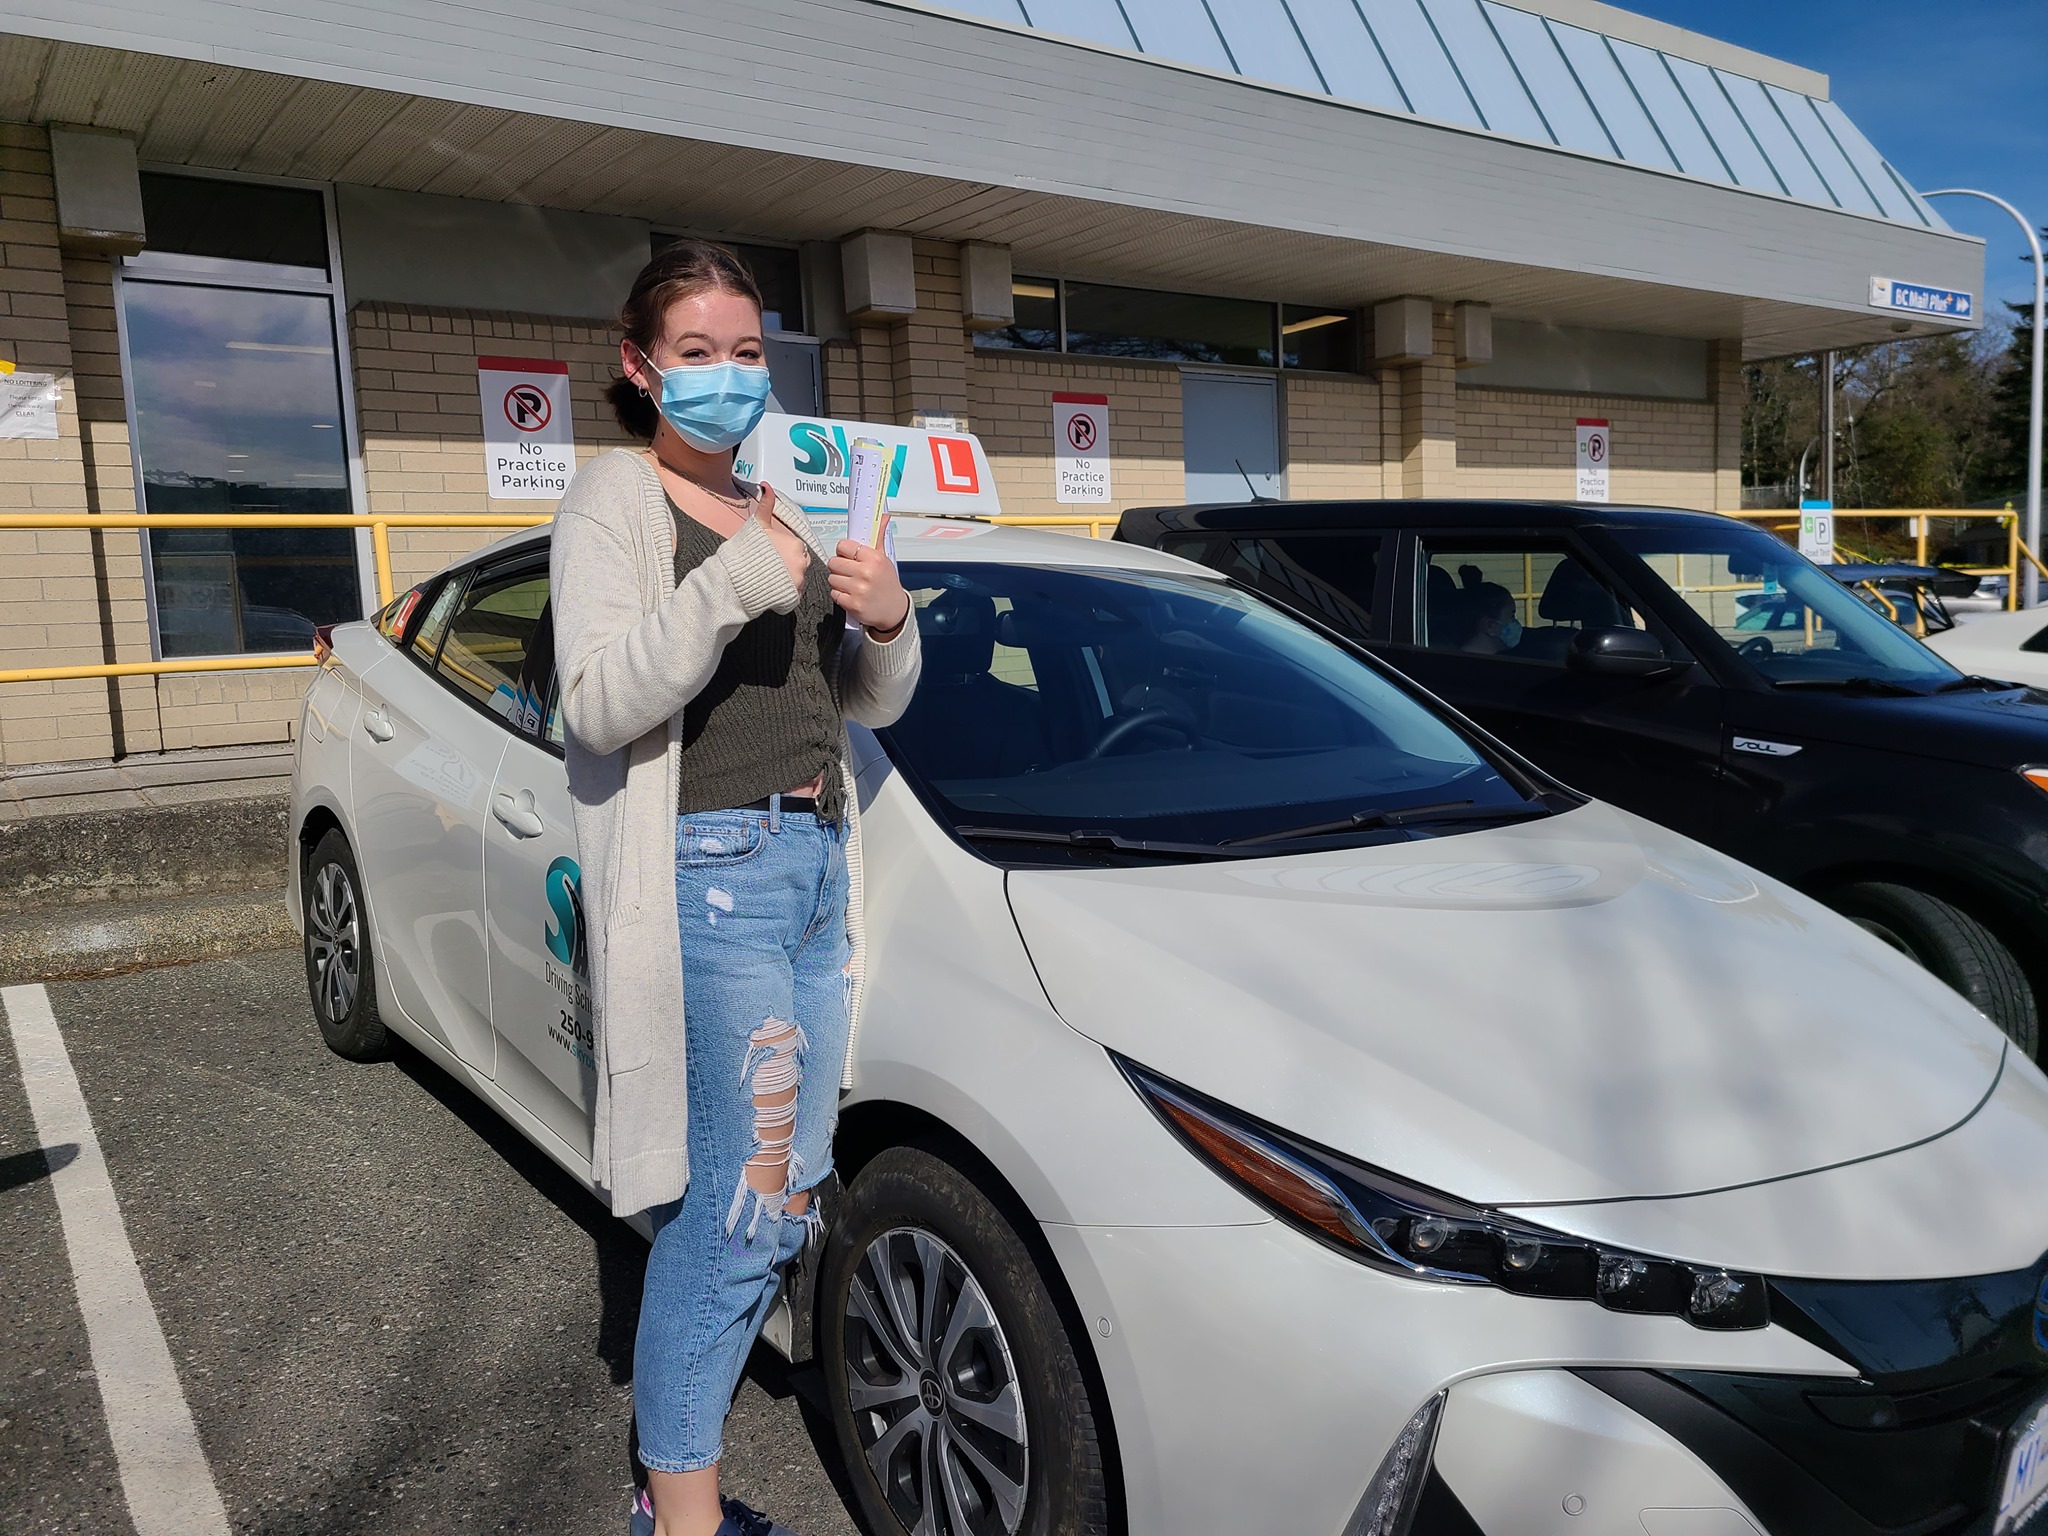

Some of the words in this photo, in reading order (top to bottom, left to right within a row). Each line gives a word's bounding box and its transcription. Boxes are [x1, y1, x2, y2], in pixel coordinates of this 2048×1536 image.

[16, 379, 48, 387] LOITERING
[519, 442, 543, 456] No
[497, 458, 567, 472] Practice
[1075, 459, 1090, 469] No
[501, 475, 565, 491] Parking
[1062, 471, 1105, 482] Practice
[1580, 477, 1605, 486] Practice
[795, 478, 828, 496] Driving
[829, 481, 850, 495] Scho
[1064, 485, 1103, 497] Parking
[1581, 487, 1604, 497] Parking
[545, 960, 573, 1005] Driving
[574, 983, 593, 1016] Sch
[560, 1009, 594, 1050] 250-9
